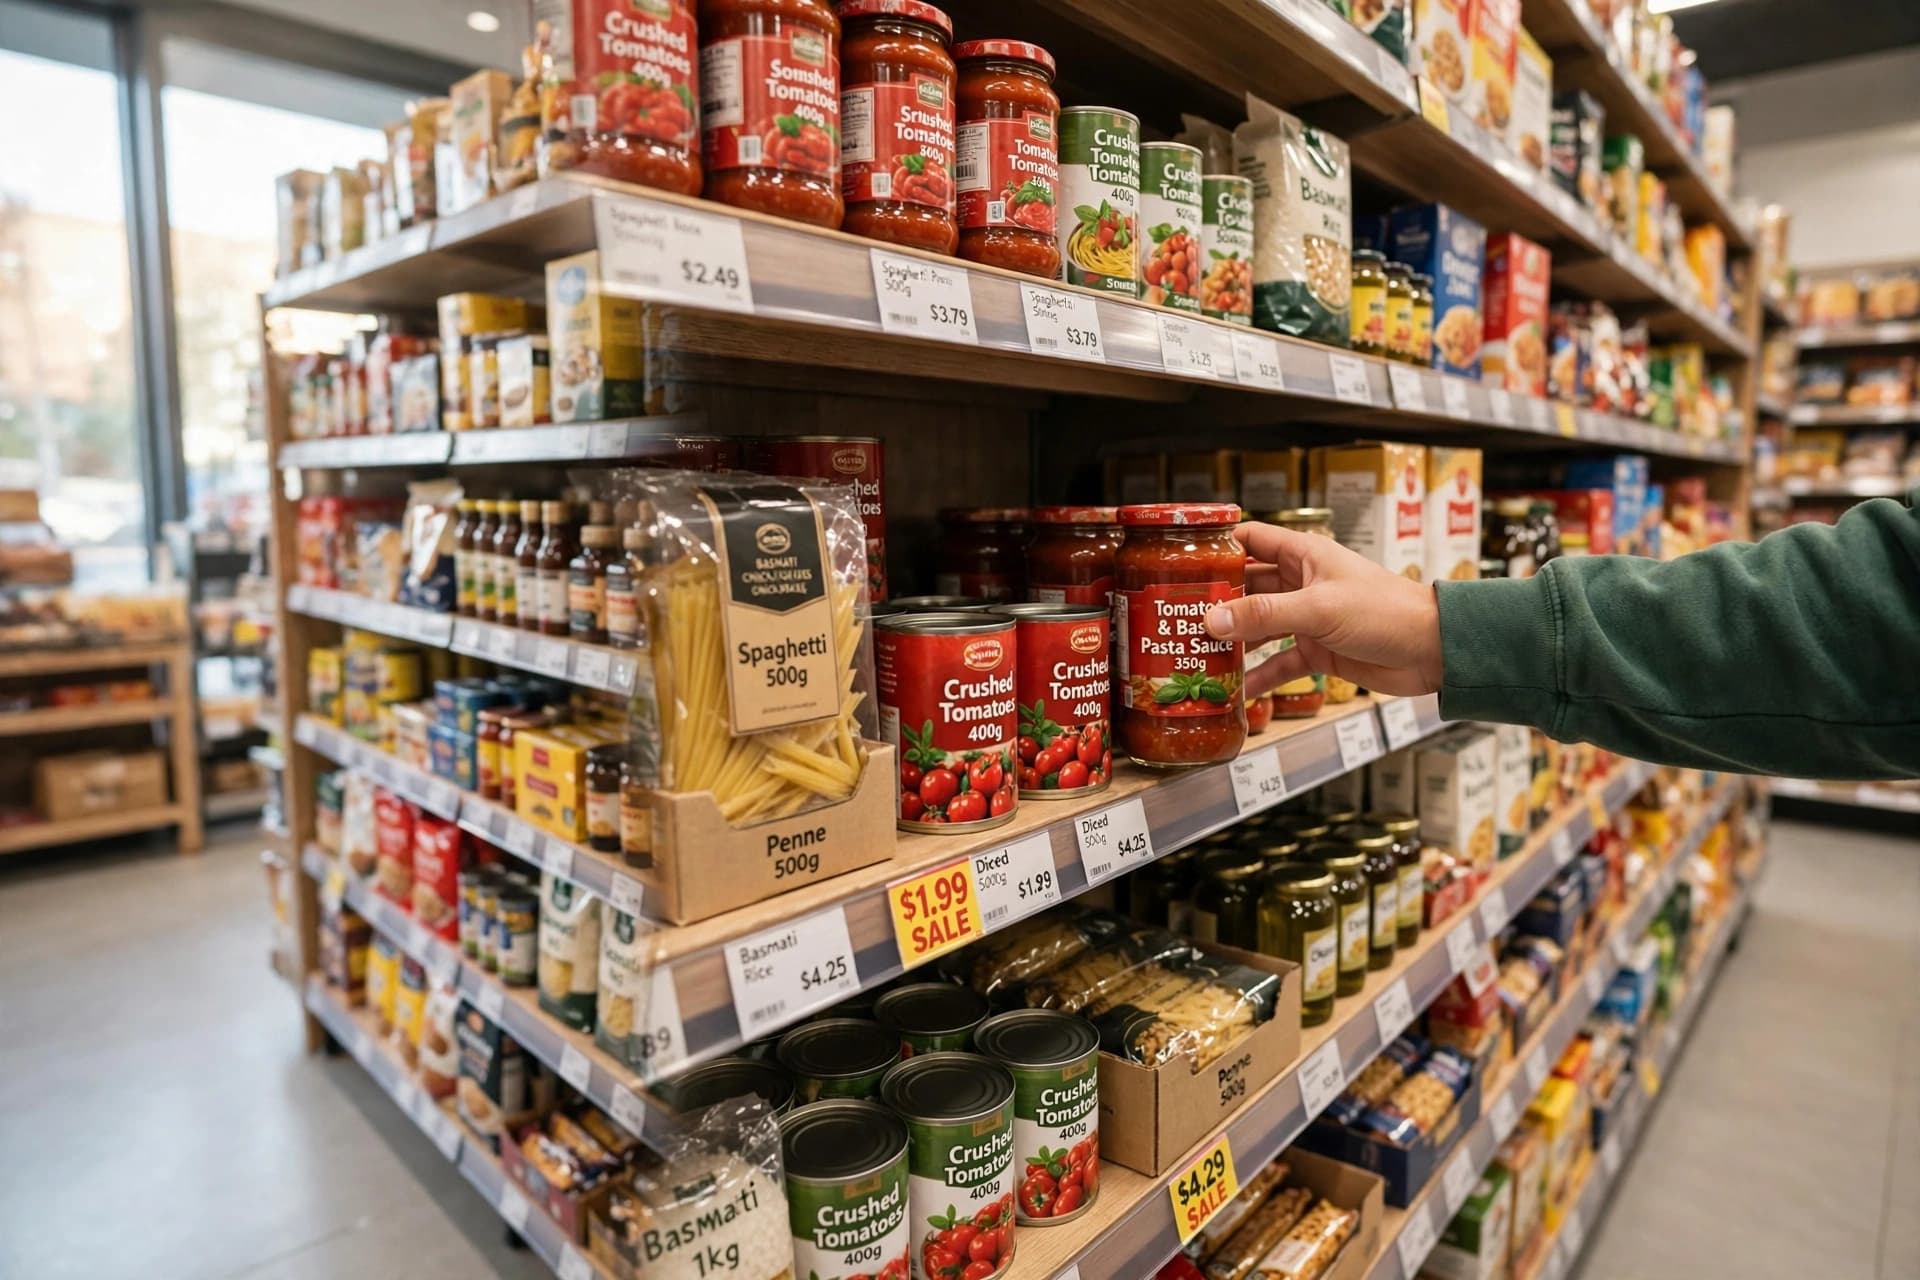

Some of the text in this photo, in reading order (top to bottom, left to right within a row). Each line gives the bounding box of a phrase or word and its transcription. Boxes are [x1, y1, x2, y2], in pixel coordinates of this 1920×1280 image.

[604, 10, 687, 53] Crushed
[597, 32, 691, 75] Tomatoes
[681, 259, 739, 289] $2.49
[930, 304, 968, 326] $3.79
[1066, 326, 1097, 347] $3.79
[1157, 619, 1206, 636] & Bas
[738, 633, 827, 668] Spaghetti
[1141, 637, 1234, 655] Pasta Sauce
[767, 665, 808, 688] 500g
[1053, 654, 1109, 680] Crushed
[1174, 657, 1207, 672] 350g
[944, 670, 1013, 701] Crushed
[938, 698, 1016, 723] Tomatoes
[1073, 701, 1102, 718] 400g
[968, 723, 1003, 742] 400g
[1082, 814, 1109, 834] Diced
[767, 827, 827, 857] Penne
[1118, 833, 1146, 857] $4.25
[775, 852, 820, 879] 500g
[976, 849, 1009, 874] Diced
[900, 871, 969, 922] $1.99
[911, 907, 972, 953] SALE
[739, 930, 799, 966] Basmati
[800, 956, 848, 991] $4.25
[1041, 1066, 1097, 1106] Crushed
[1035, 1088, 1098, 1125] Tomatoes
[949, 1119, 1013, 1165] Crushed
[1059, 1122, 1087, 1140] 400g
[944, 1142, 1014, 1186] Tomatoes
[1178, 1149, 1226, 1207] $4.29
[817, 1180, 900, 1227] Crushed
[970, 1180, 1000, 1200] 400g
[1187, 1178, 1229, 1233] SALE
[643, 1180, 759, 1262] Basmati
[812, 1204, 903, 1249] Tomatoes
[692, 1243, 740, 1278] 1kg
[844, 1245, 882, 1265] 400g
